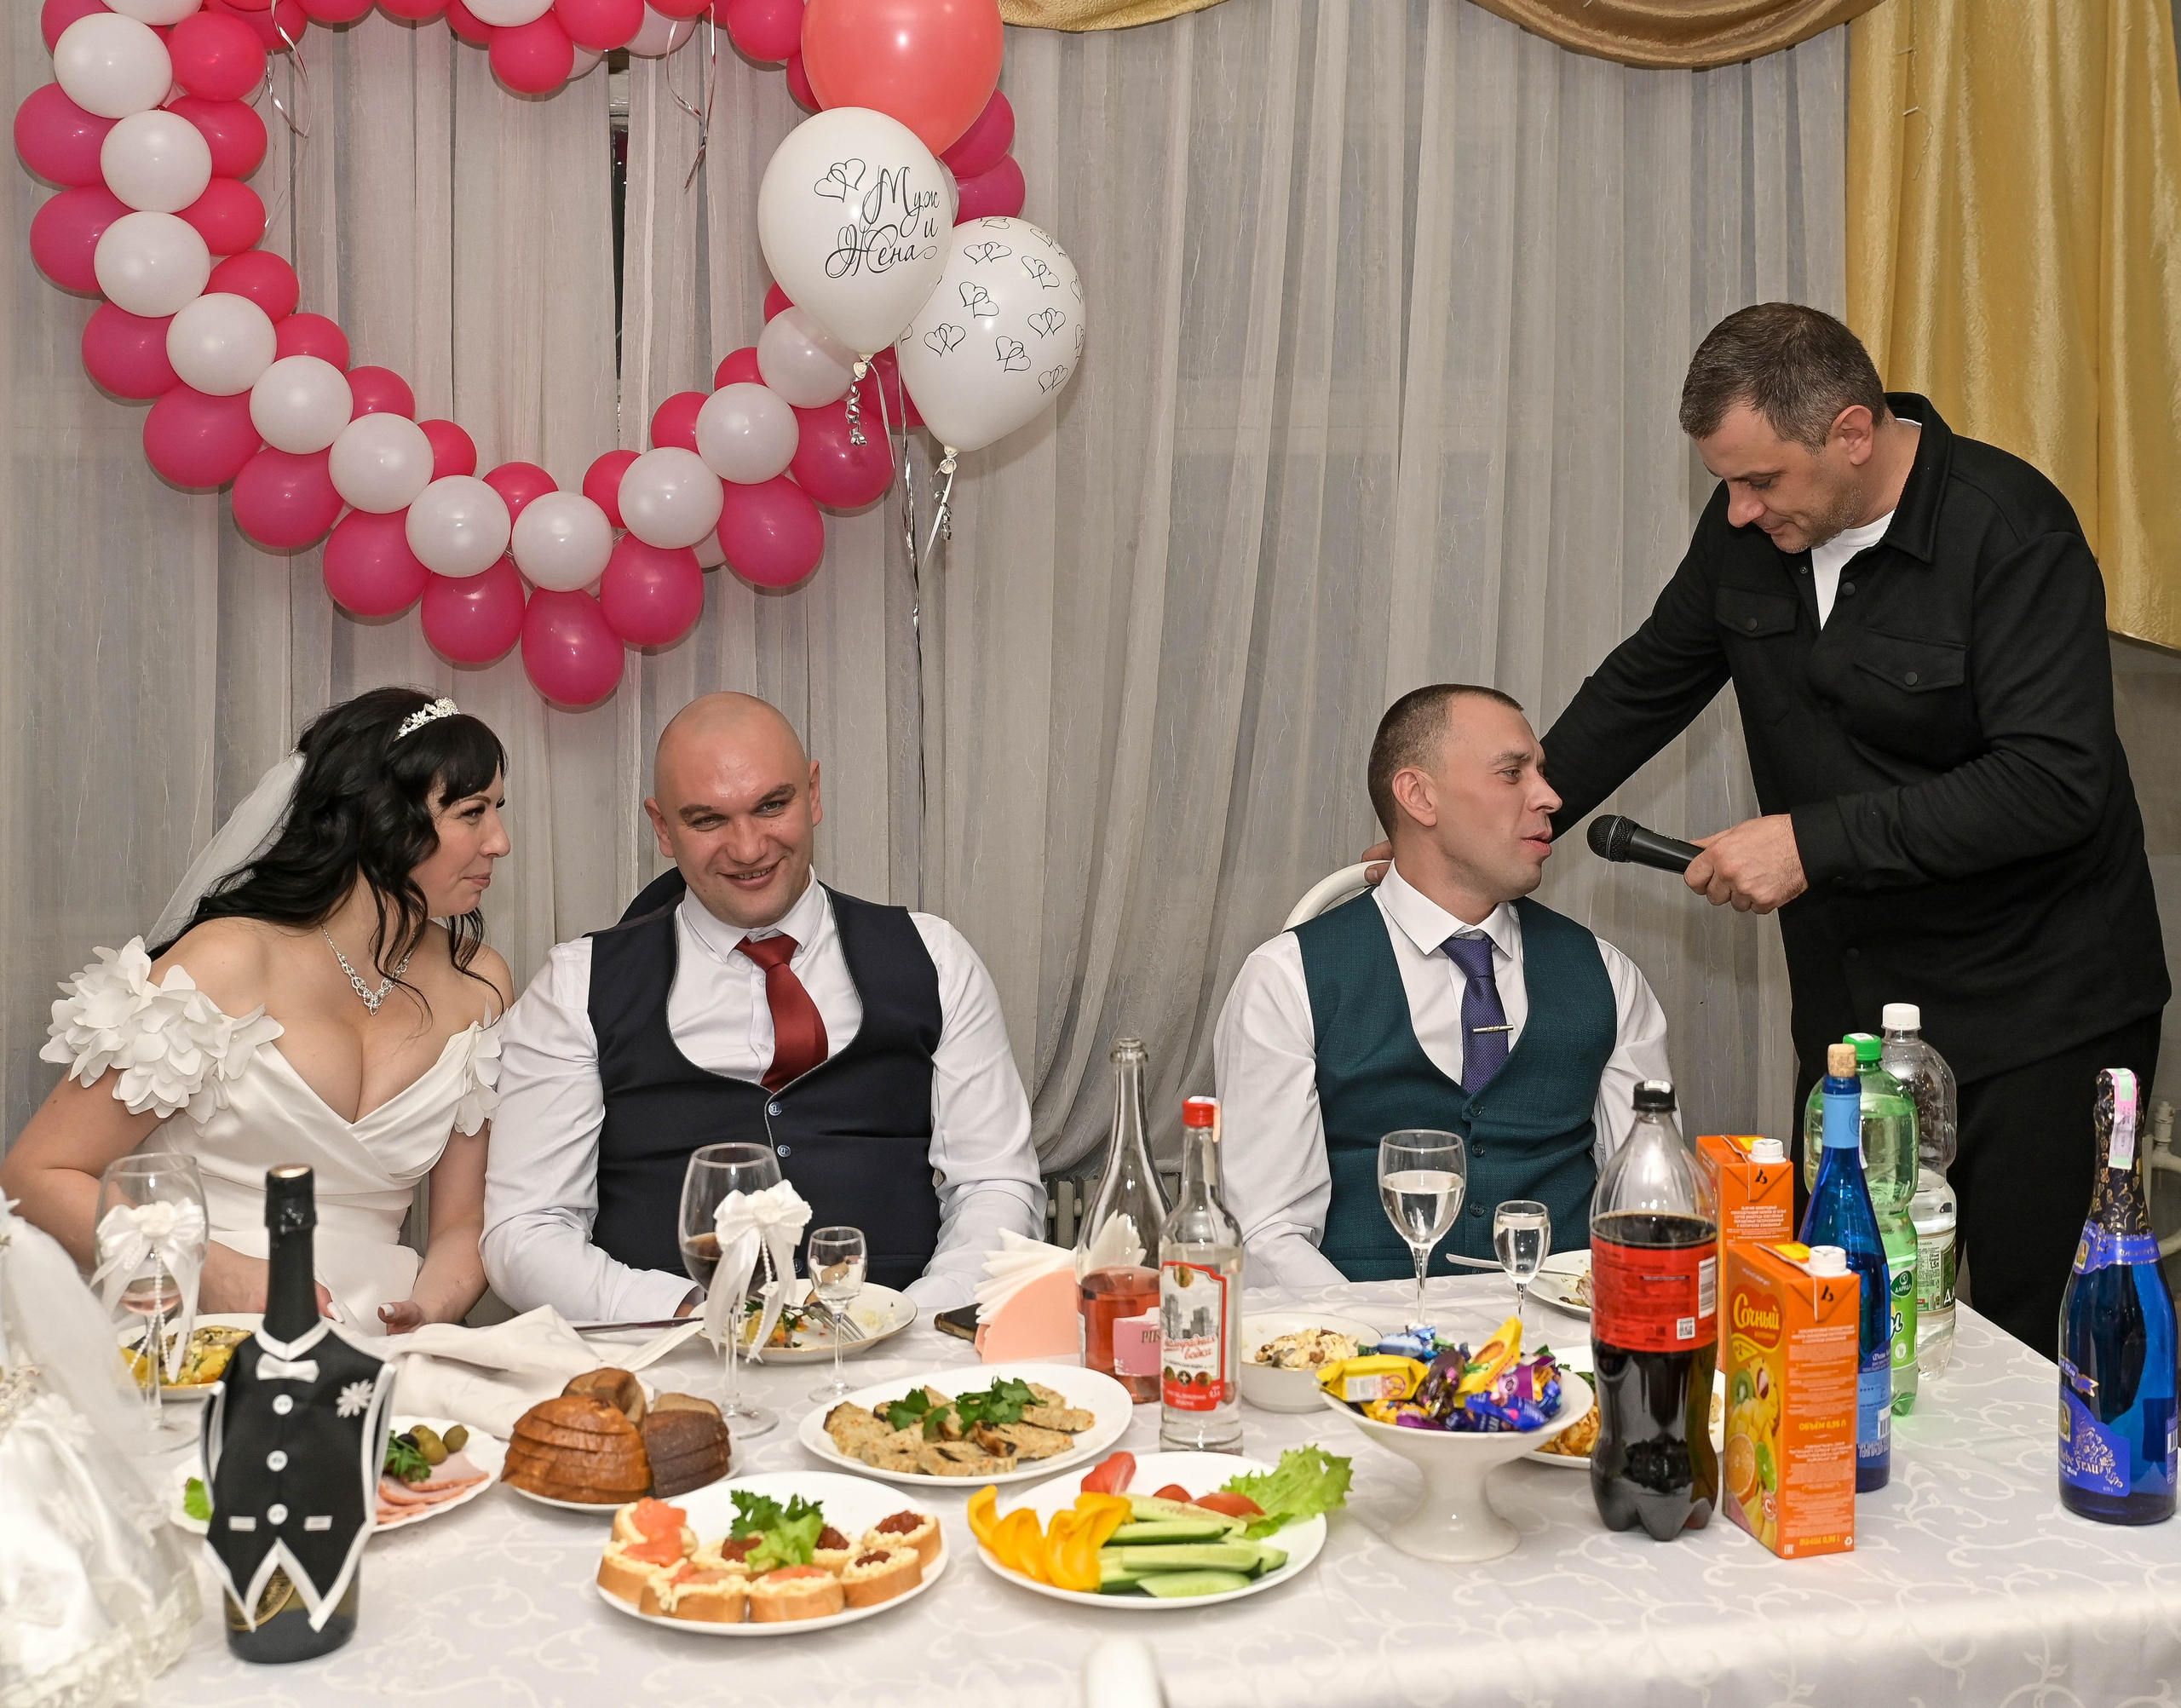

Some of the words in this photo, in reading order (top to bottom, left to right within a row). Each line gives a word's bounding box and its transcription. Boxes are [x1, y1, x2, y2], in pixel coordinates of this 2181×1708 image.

[859, 165, 940, 239] Муж
[825, 223, 938, 279] Жена
[924, 217, 939, 239] и
[1733, 1292, 1781, 1331] Сочный
